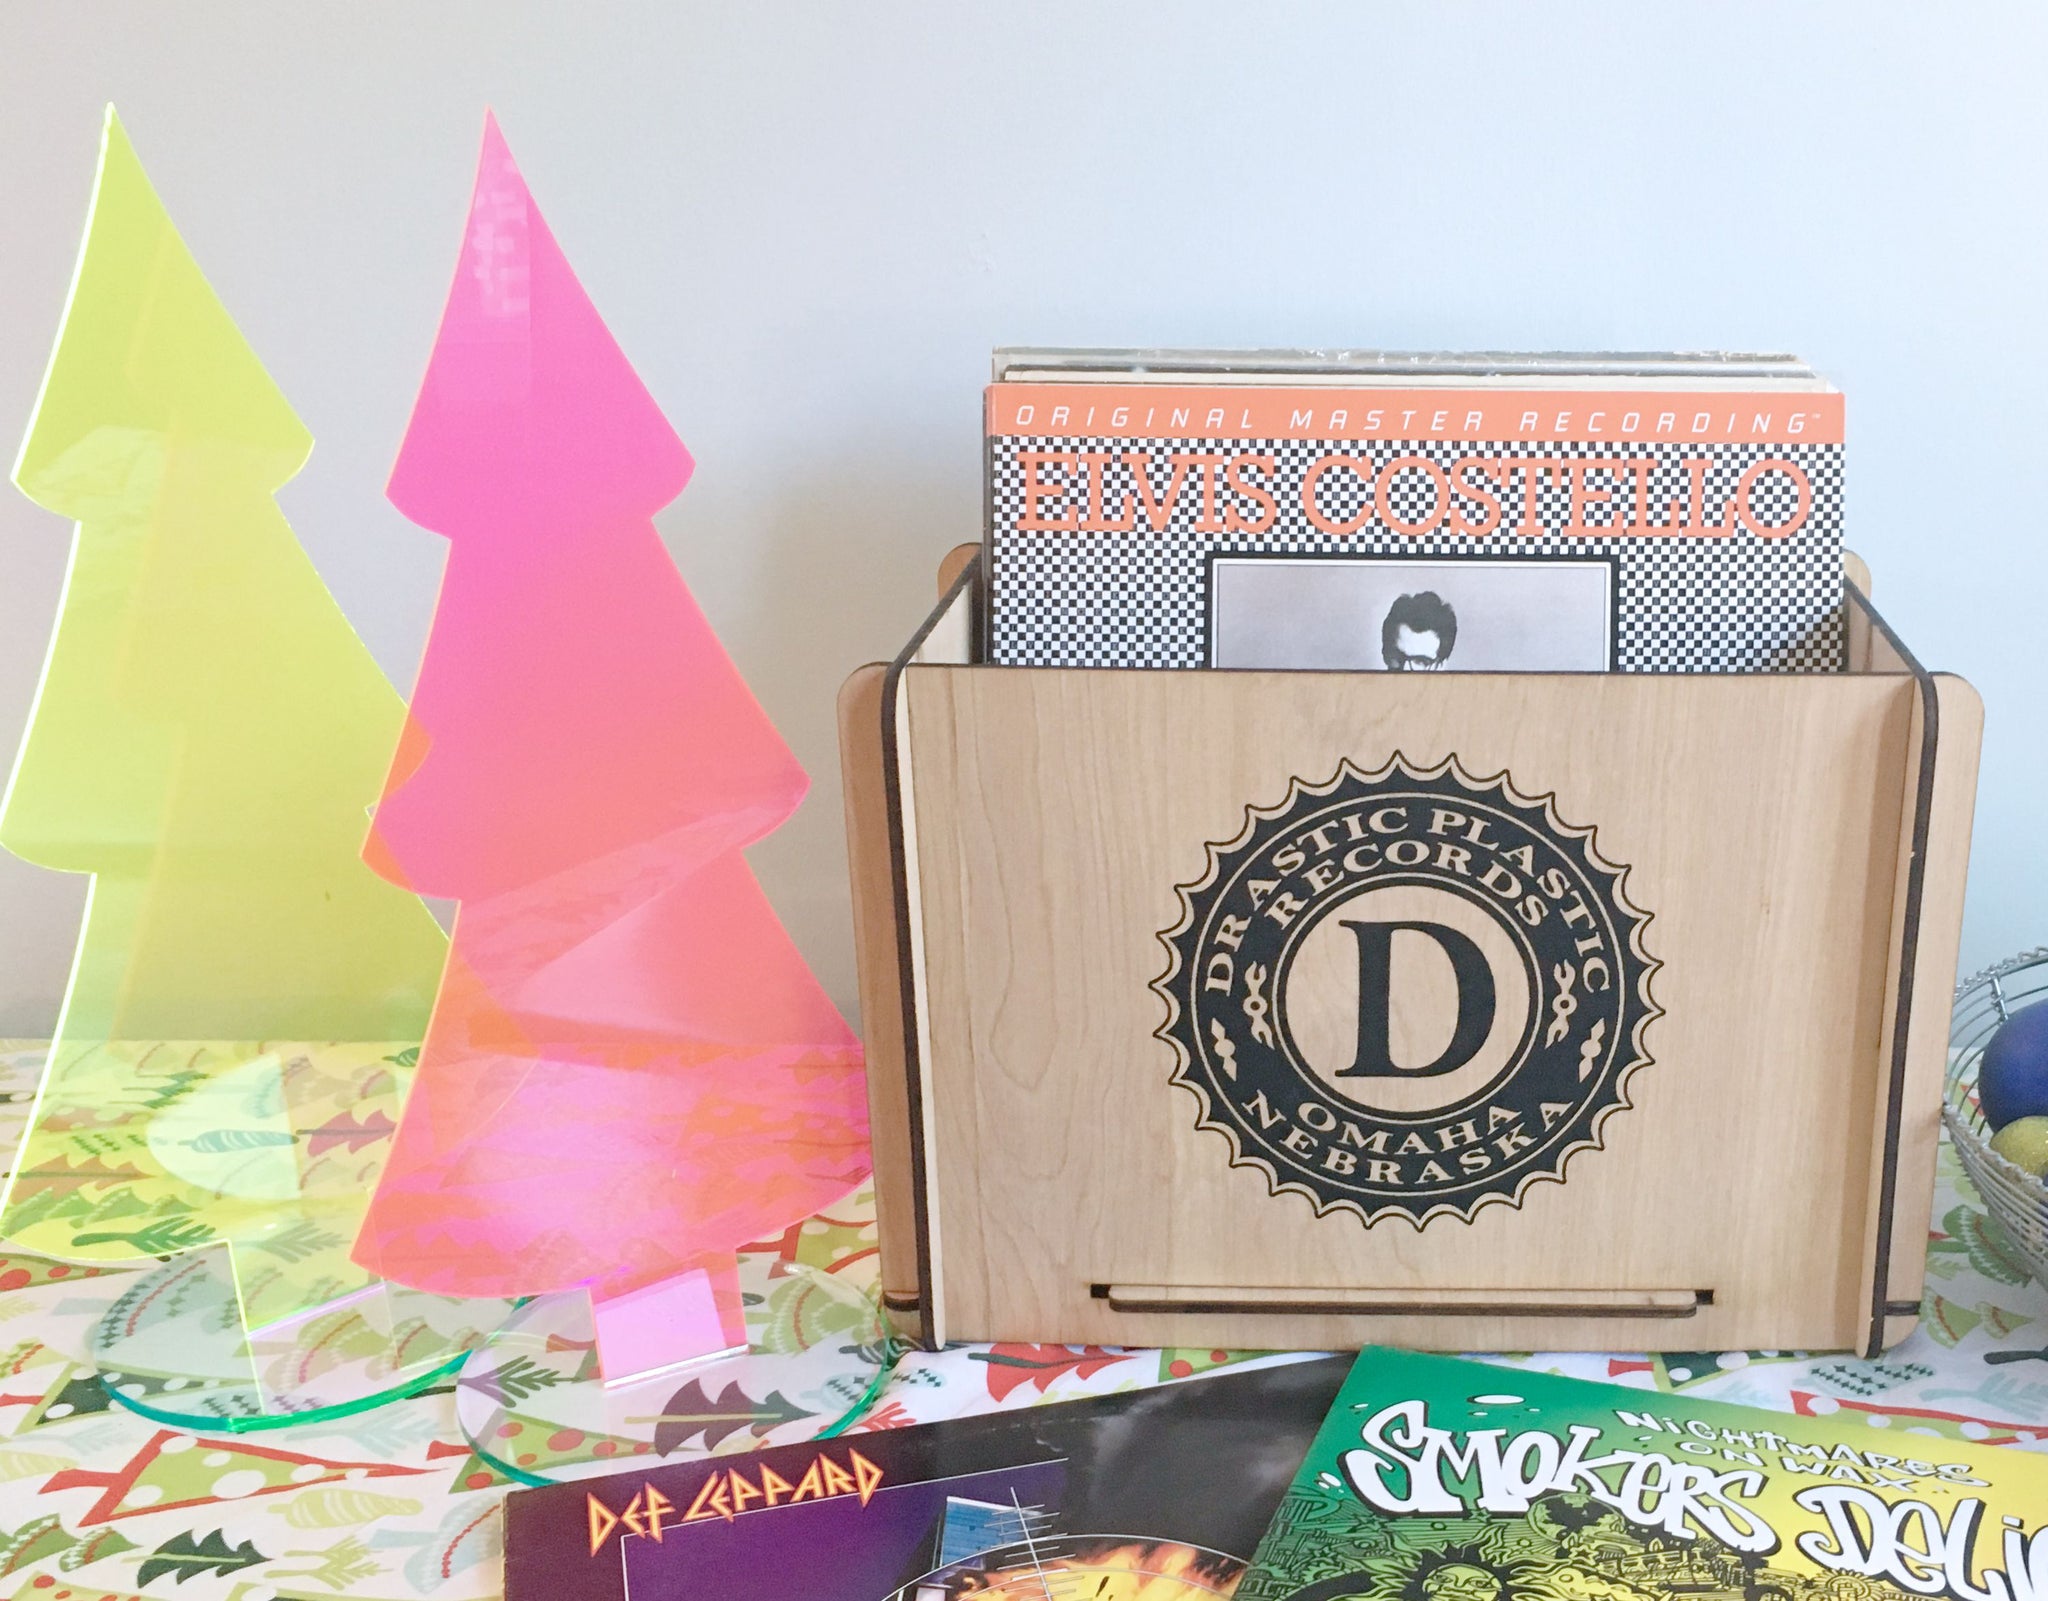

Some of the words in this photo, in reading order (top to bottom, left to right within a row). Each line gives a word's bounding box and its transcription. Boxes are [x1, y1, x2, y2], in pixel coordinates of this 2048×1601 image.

[1016, 405, 1253, 429] ORIGINAL
[1289, 409, 1483, 431] MASTER
[1016, 452, 1277, 534] ELVIS
[1302, 455, 1811, 538] COSTELLO
[1206, 807, 1409, 996] DRASTIC
[1430, 808, 1610, 993] PLASTIC
[1264, 840, 1550, 930] RECORDS
[1335, 920, 1496, 1077] D
[1242, 1089, 1574, 1184] NEBRASKA
[1298, 1102, 1521, 1156] OMAHA
[587, 1482, 676, 1557] DEF
[681, 1448, 884, 1523] LEPPARD
[1677, 1440, 1768, 1467] ON
[1781, 1455, 1918, 1494] WAX
